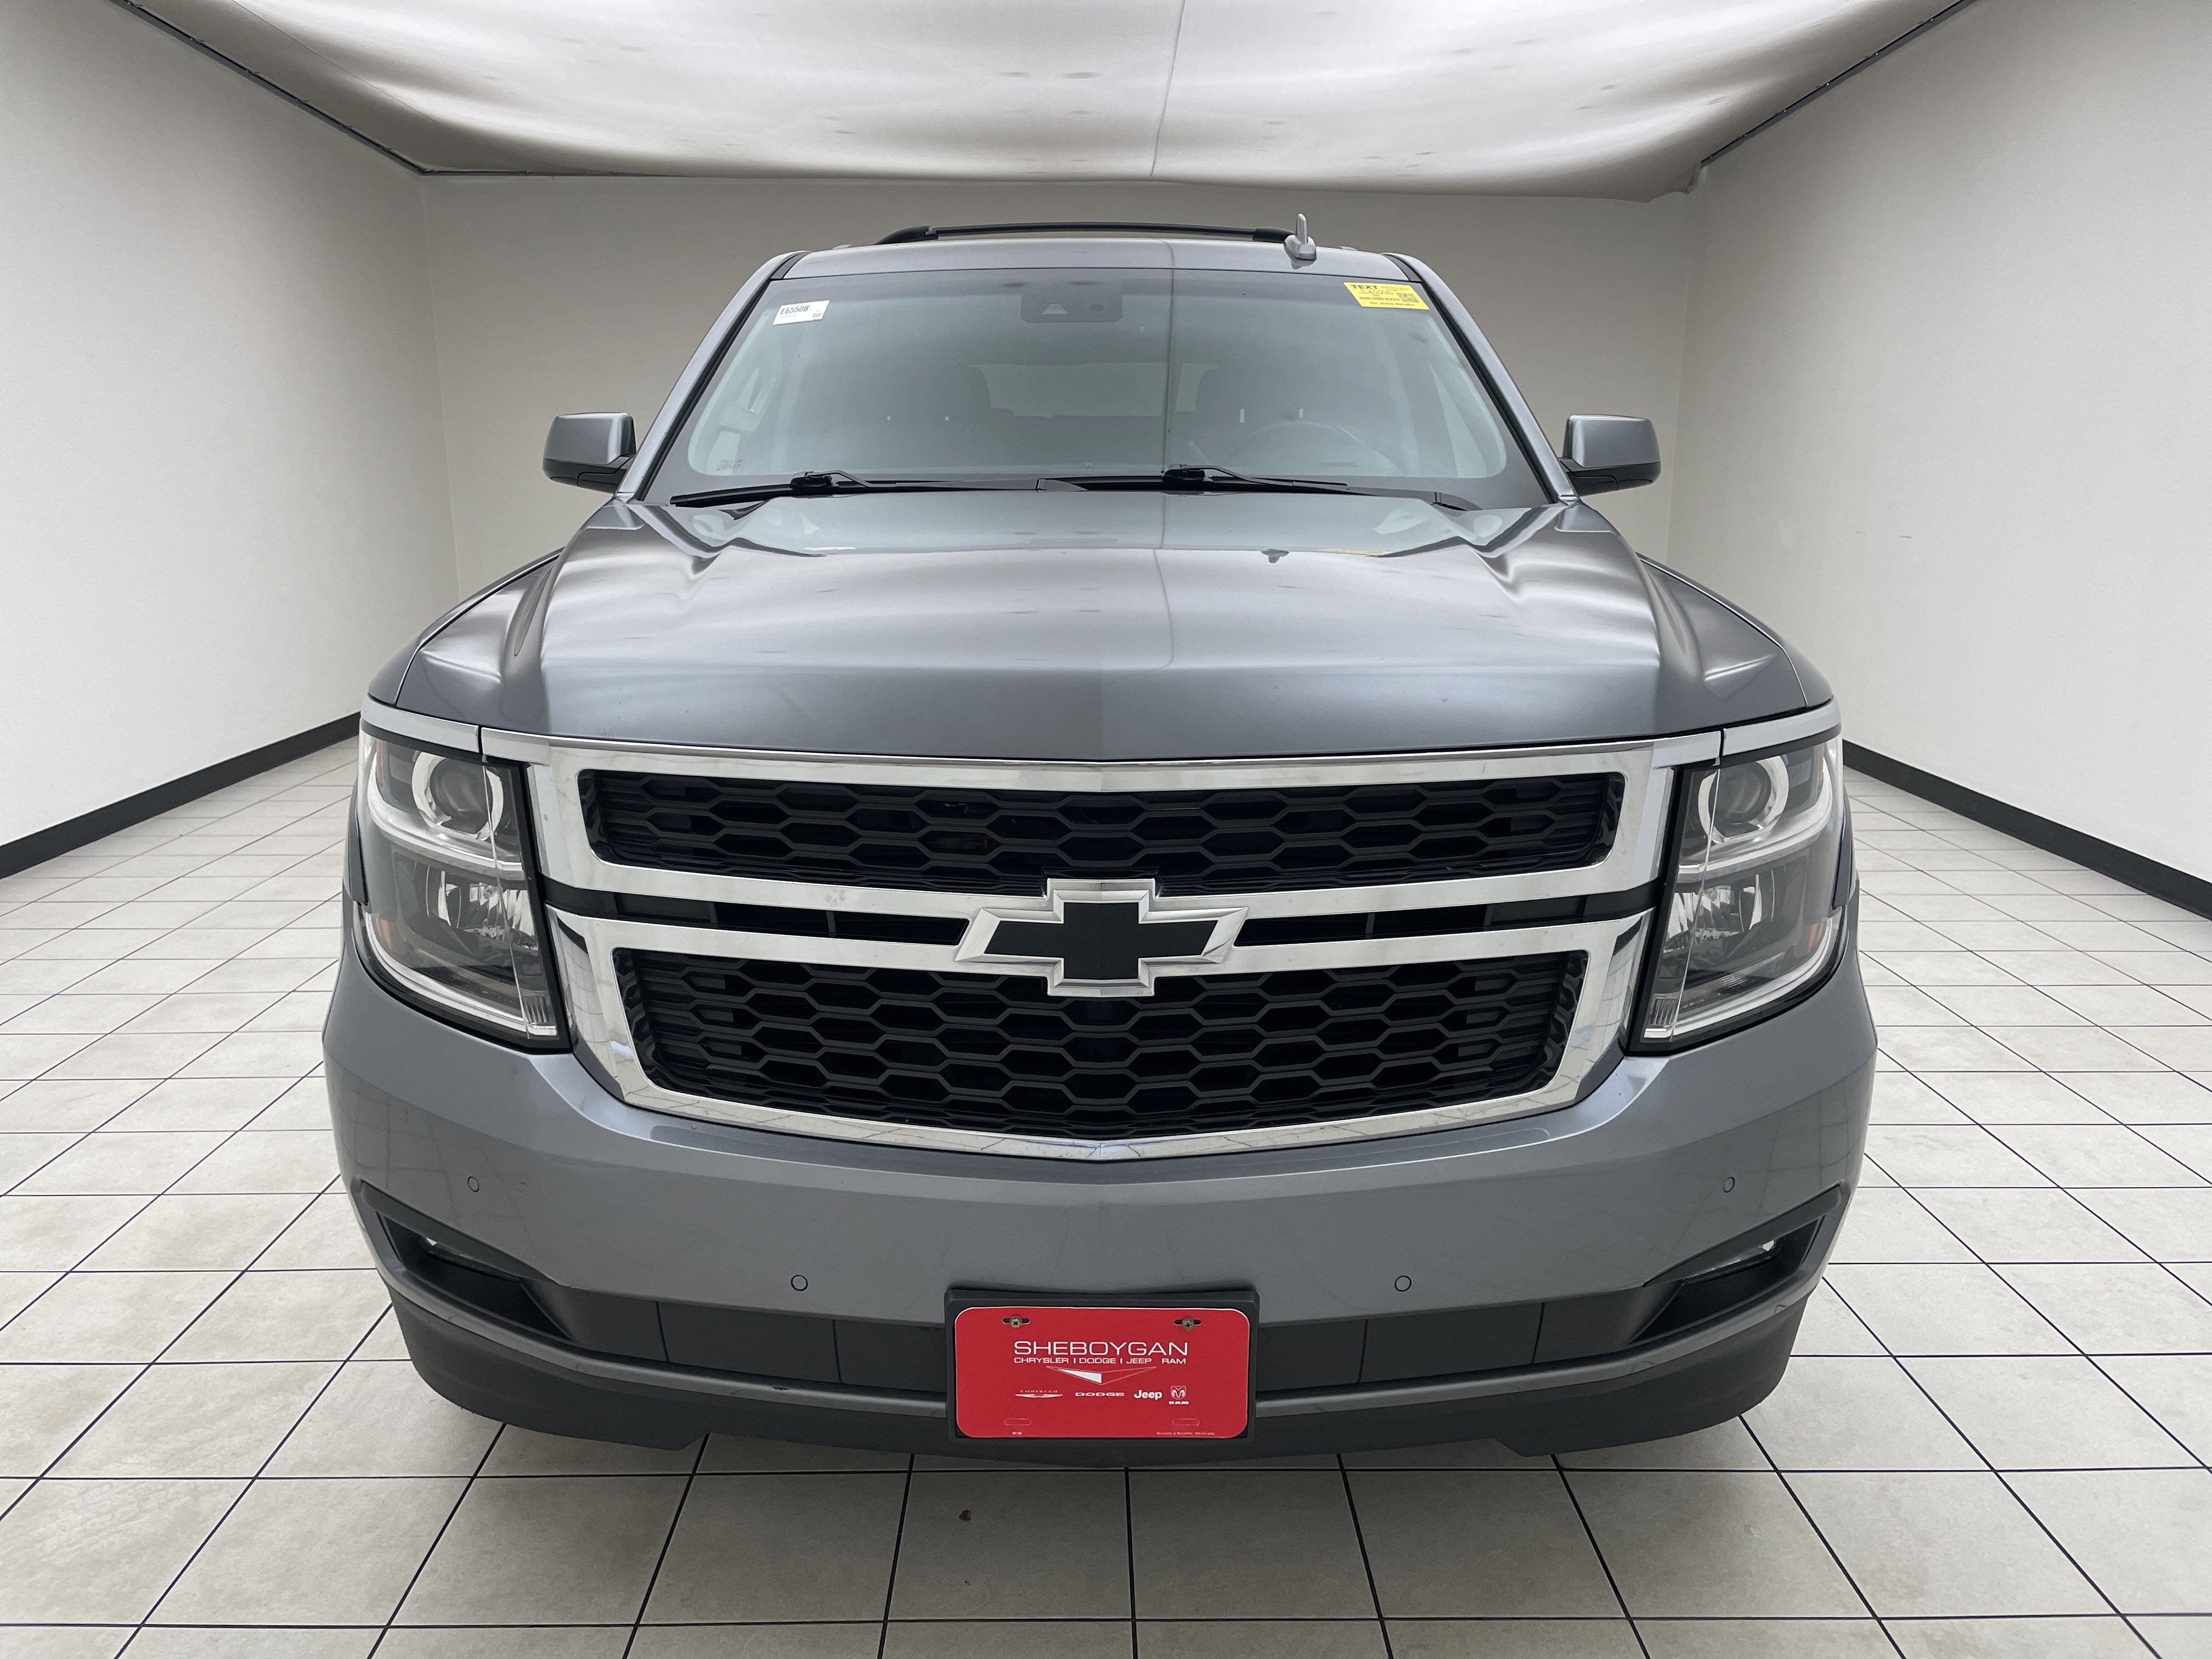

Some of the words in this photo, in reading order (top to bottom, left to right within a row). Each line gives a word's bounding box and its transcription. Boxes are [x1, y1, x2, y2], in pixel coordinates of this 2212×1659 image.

[780, 305, 810, 315] E6550B
[1014, 1340, 1188, 1356] SHEBOYGAN
[1133, 1389, 1163, 1400] Jeep
